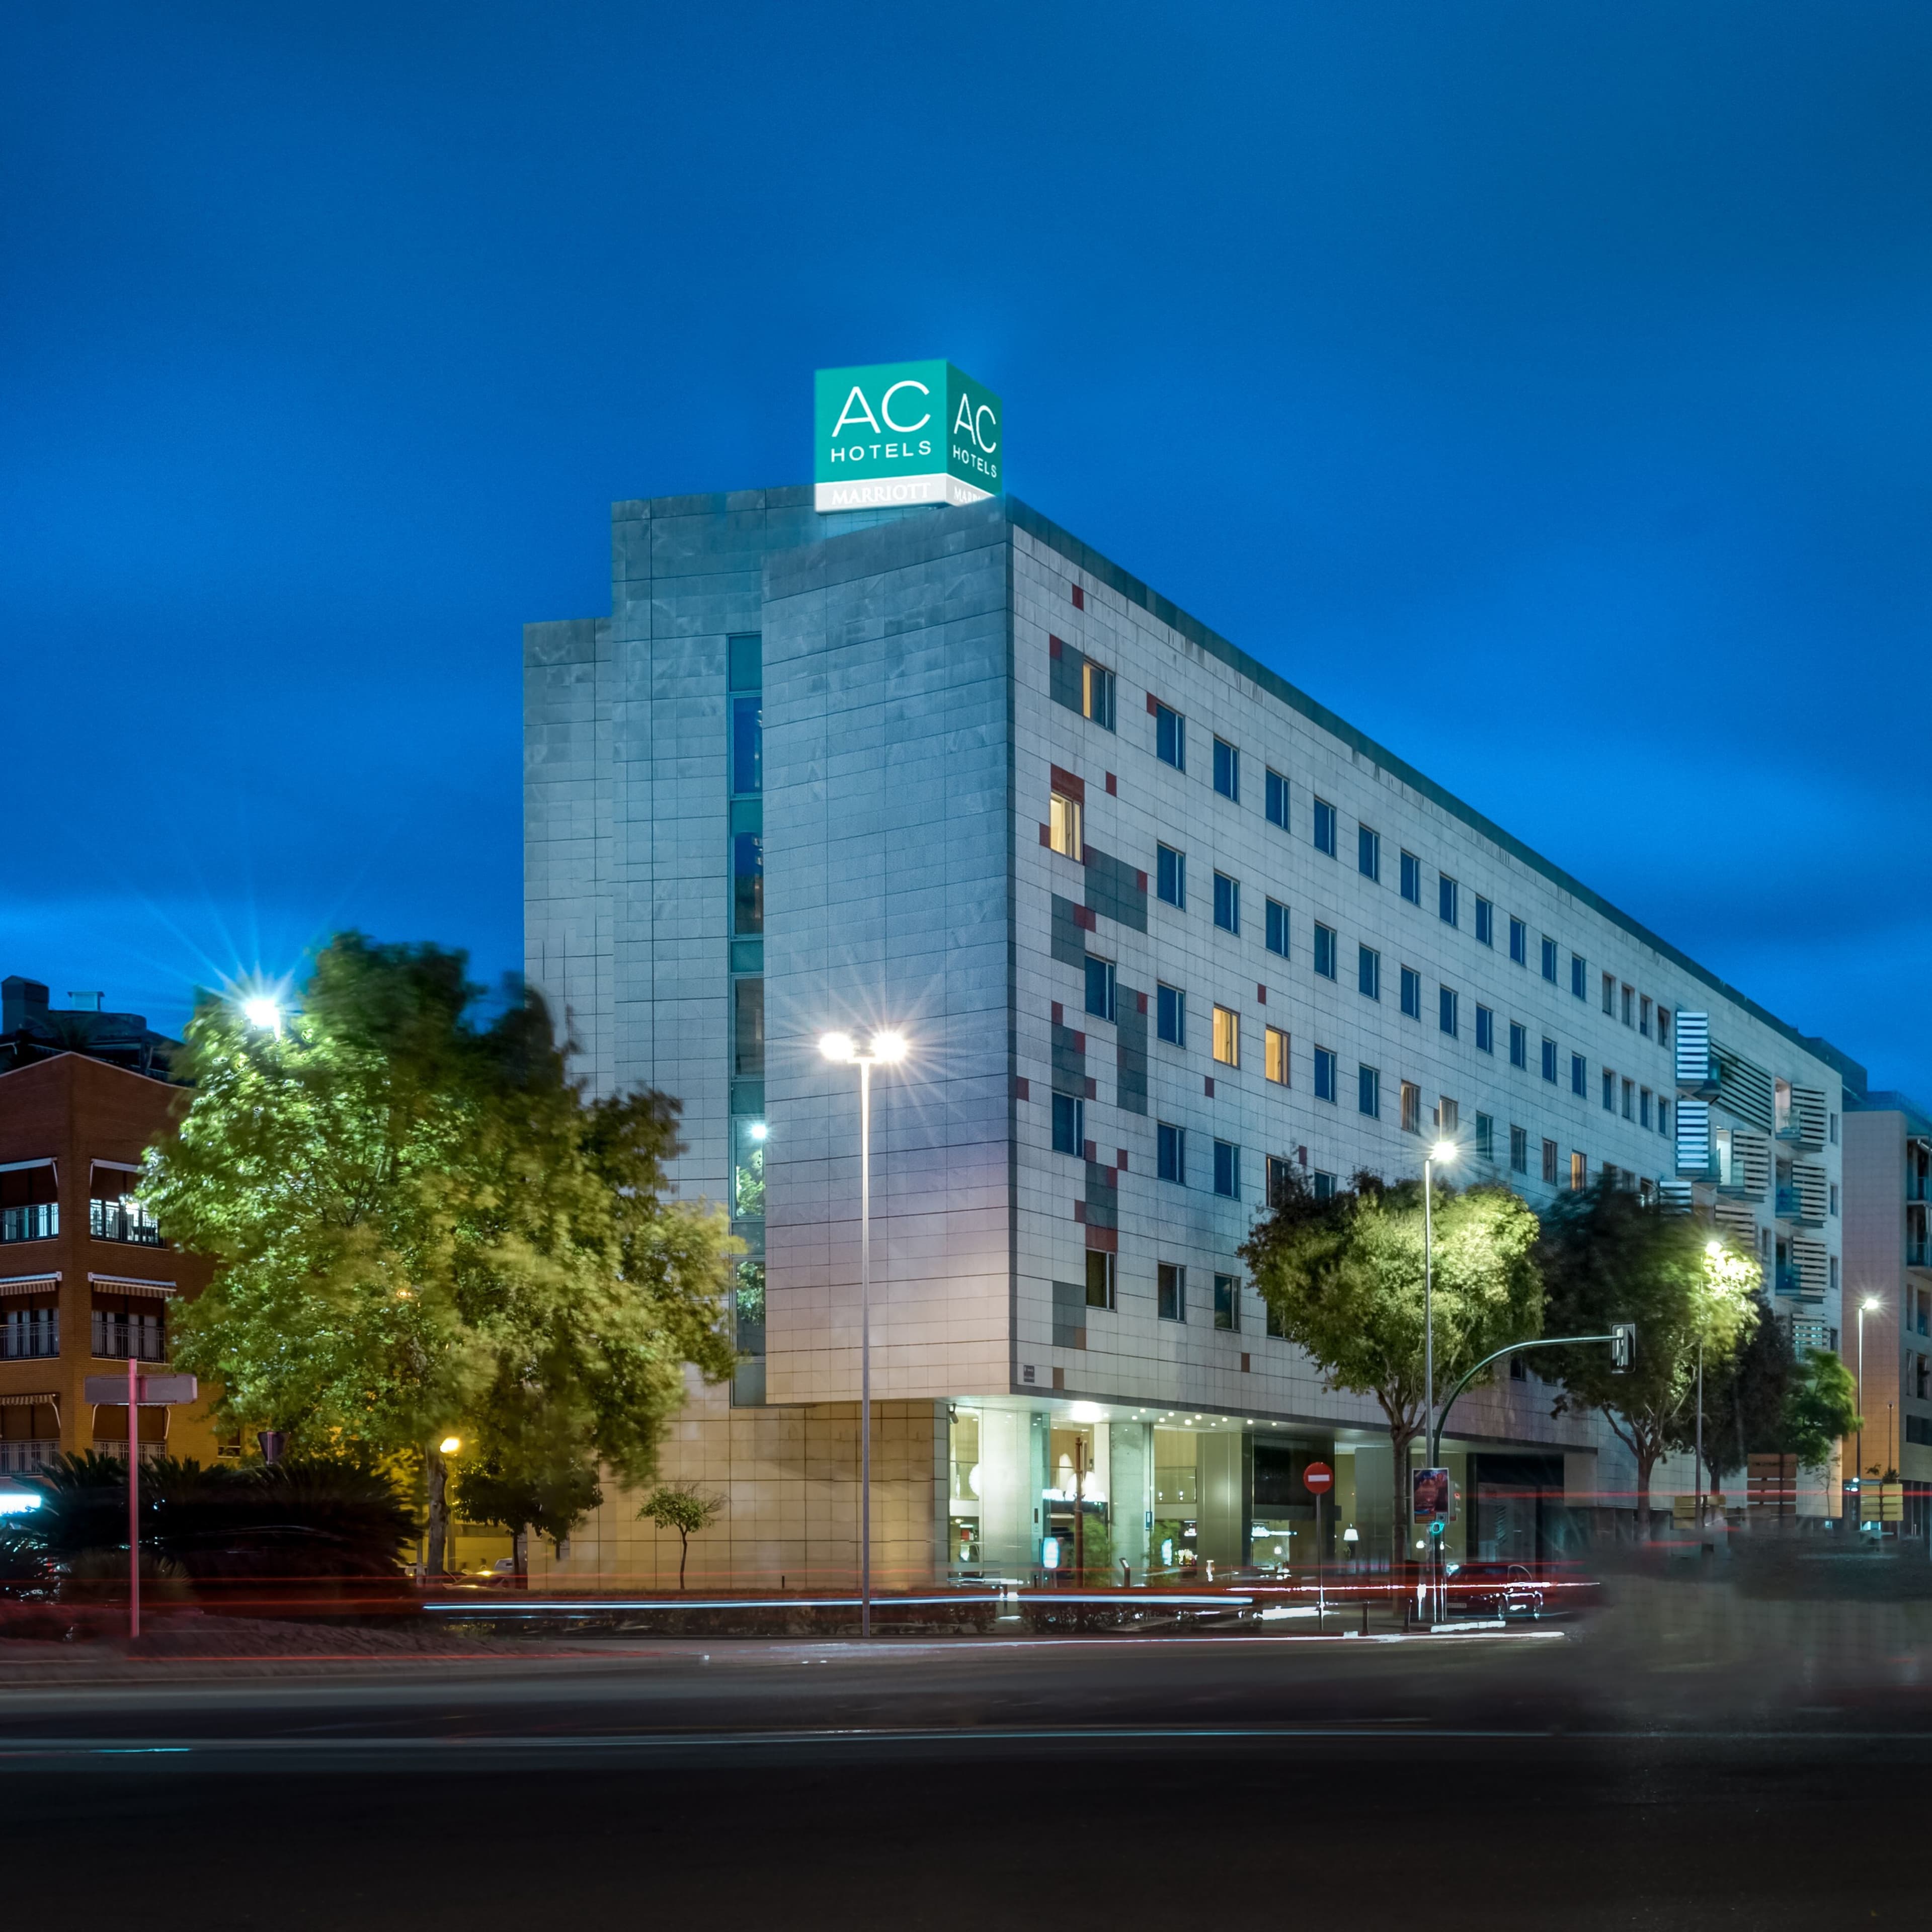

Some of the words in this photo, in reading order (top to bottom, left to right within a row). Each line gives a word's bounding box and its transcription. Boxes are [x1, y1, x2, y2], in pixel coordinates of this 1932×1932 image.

[831, 380, 931, 437] AC
[954, 393, 997, 453] AC
[831, 440, 931, 462] HOTELS
[953, 445, 997, 478] HOTELS
[831, 482, 931, 505] MARRIOTT
